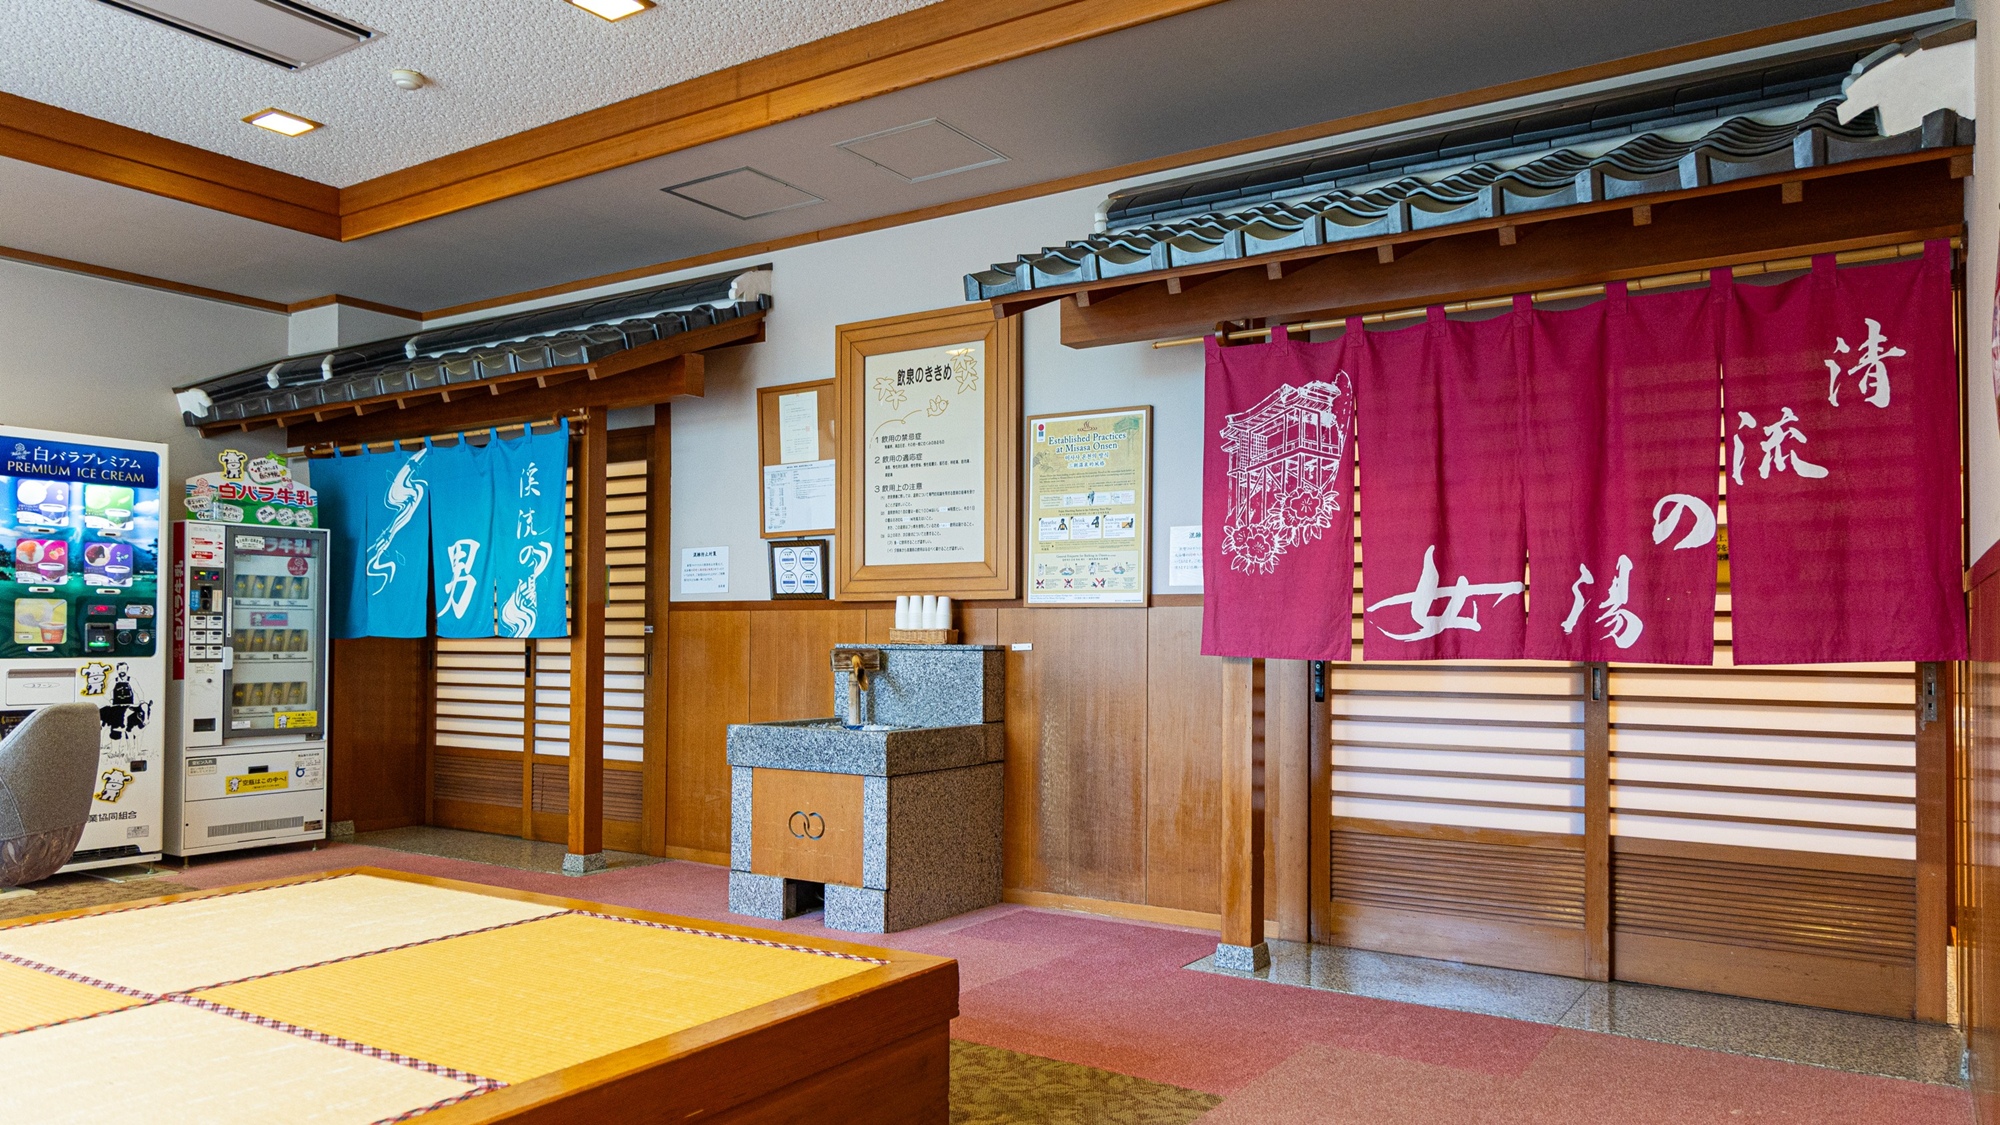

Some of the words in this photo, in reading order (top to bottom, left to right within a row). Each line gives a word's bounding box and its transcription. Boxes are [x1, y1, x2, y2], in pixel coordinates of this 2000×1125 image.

[897, 363, 952, 386] 飲泉のききめ
[1048, 434, 1090, 445] Established
[1093, 432, 1126, 441] Practices
[1065, 444, 1090, 452] Misasa
[1093, 441, 1118, 450] Onsen
[34, 446, 141, 469] 白バラプレミアム
[874, 456, 880, 464] 2
[7, 460, 70, 476] PREMIUM
[77, 468, 97, 479] ICE
[101, 469, 145, 483] CREAM
[219, 483, 314, 506] 白バラ牛乳
[874, 485, 880, 493] 3
[882, 483, 922, 492] 飲用上の注意
[437, 539, 480, 619] 男
[175, 560, 184, 641] 白バラ牛乳
[1367, 545, 1526, 642] 女
